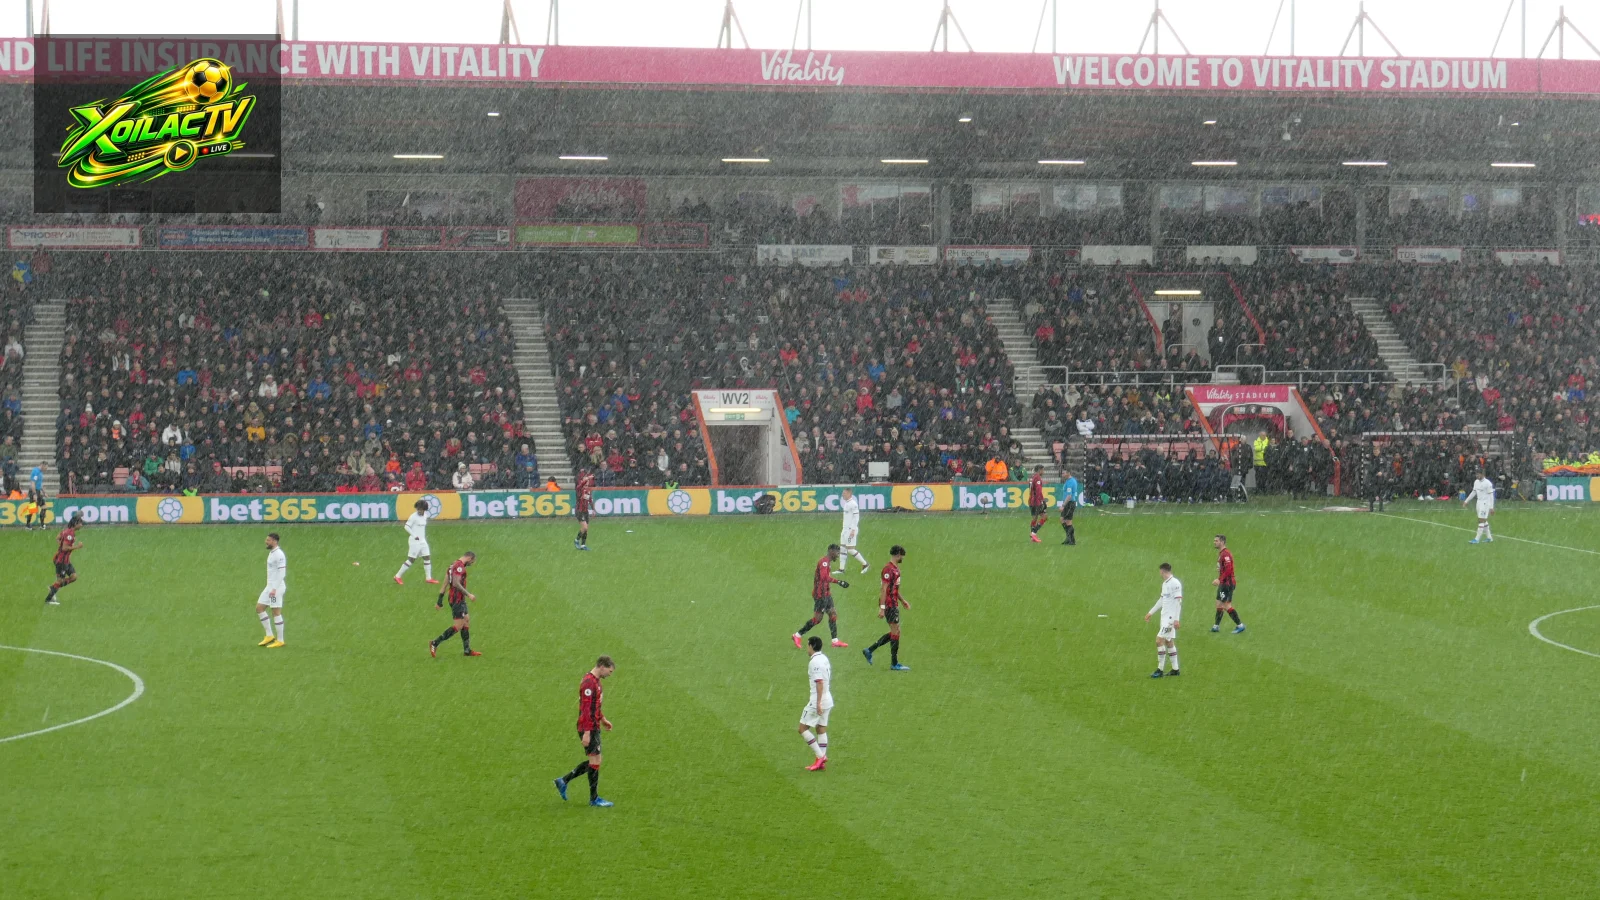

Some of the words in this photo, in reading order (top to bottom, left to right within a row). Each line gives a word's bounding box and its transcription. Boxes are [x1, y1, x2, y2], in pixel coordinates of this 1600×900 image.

[47, 41, 111, 72] LIFE
[316, 44, 400, 75] WITH
[408, 46, 545, 78] VITALITY
[761, 49, 845, 85] Vitality
[1053, 56, 1200, 87] WELCOME
[1207, 58, 1244, 87] TO
[1251, 58, 1374, 88] VITALITY
[1380, 59, 1507, 89] STADIUM
[961, 249, 989, 258] Roofing
[722, 392, 749, 405] WV2
[1206, 388, 1233, 402] Vitality
[211, 498, 389, 521] bet365.com
[468, 494, 641, 515] bet365.om
